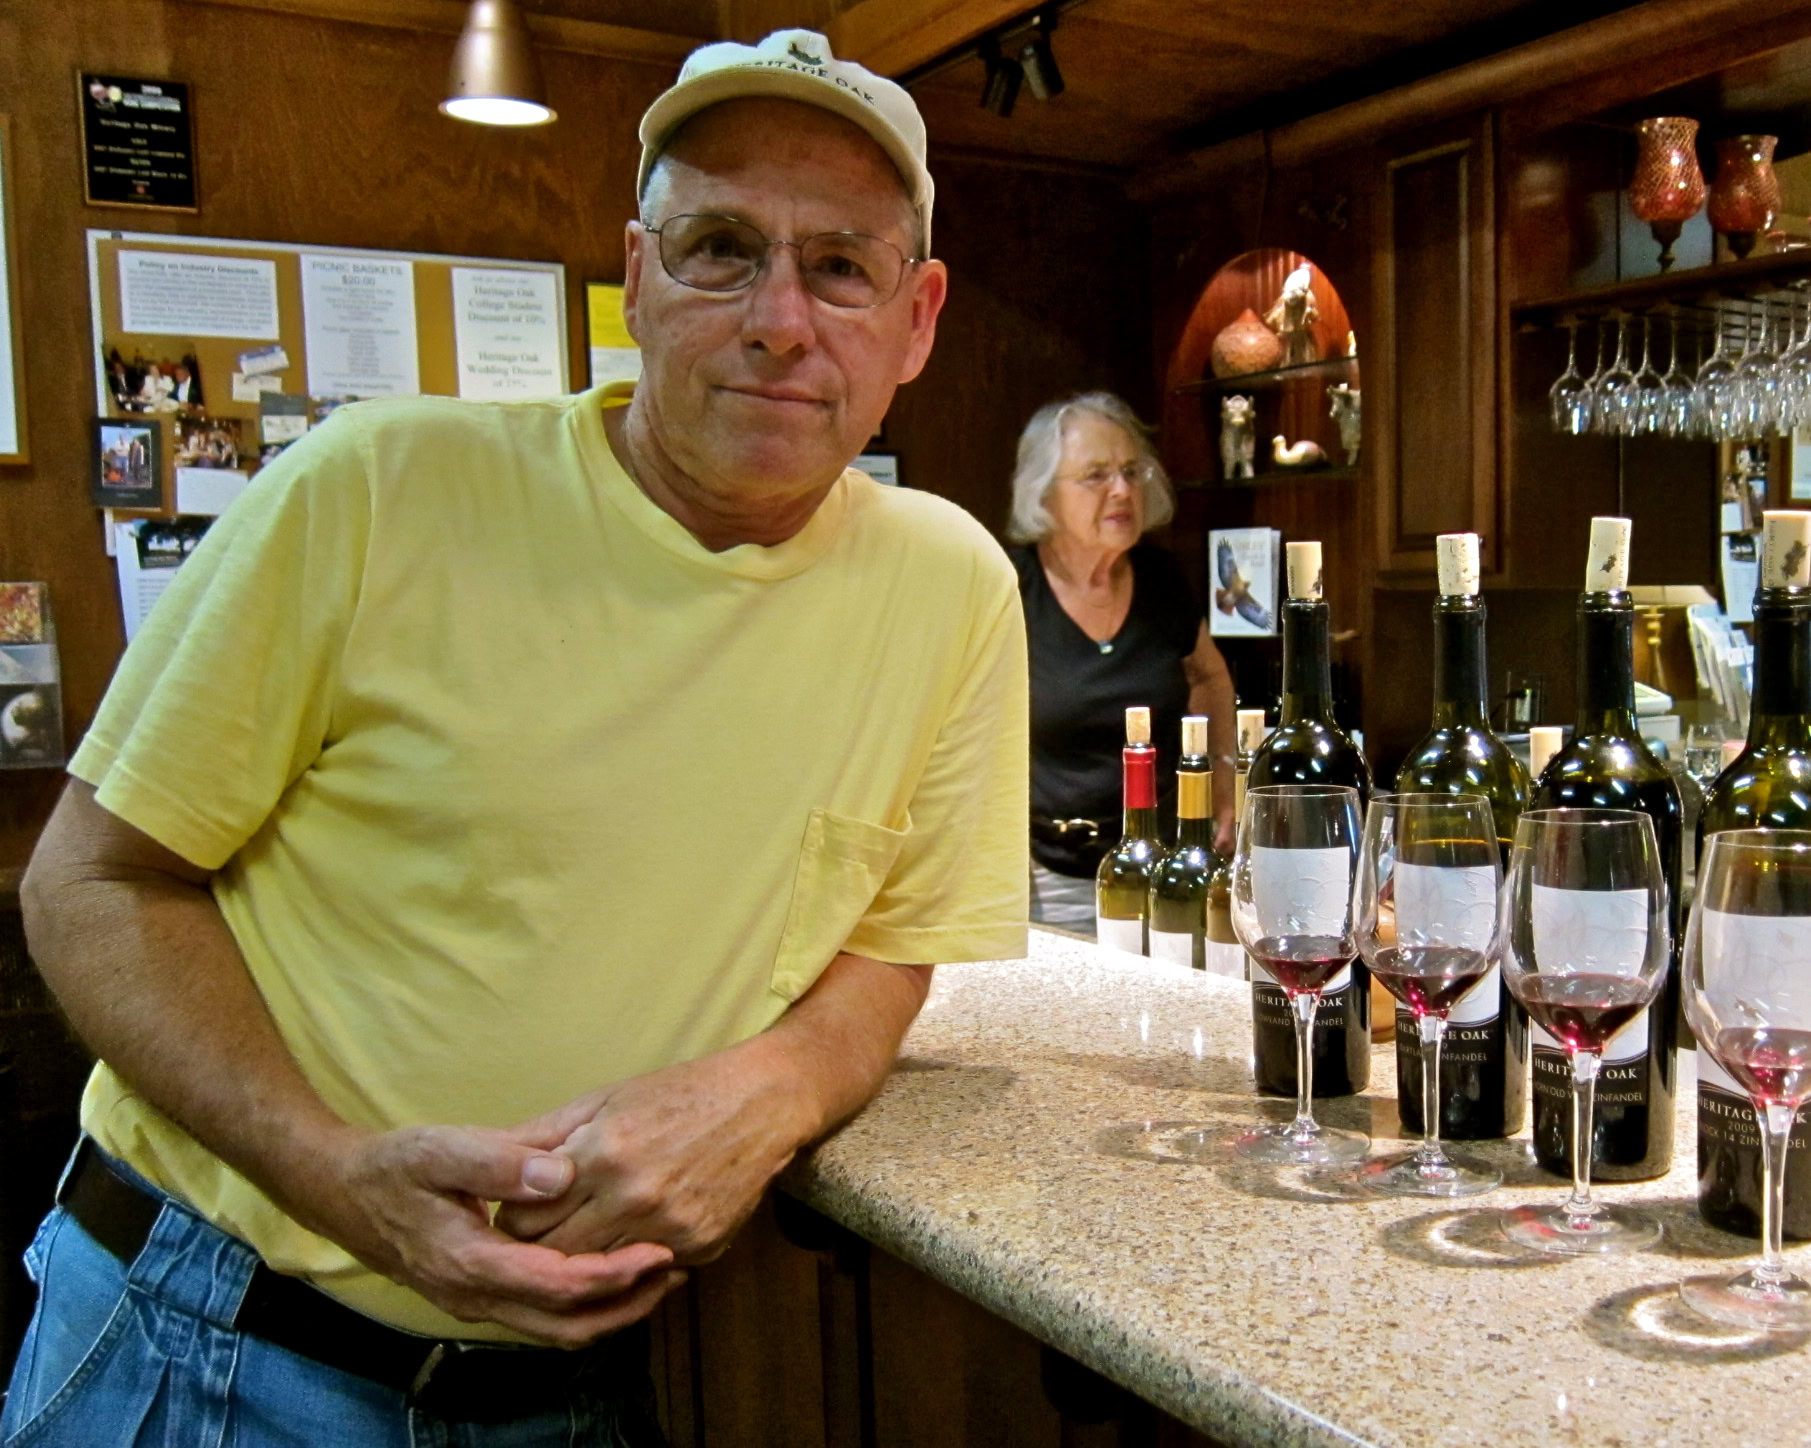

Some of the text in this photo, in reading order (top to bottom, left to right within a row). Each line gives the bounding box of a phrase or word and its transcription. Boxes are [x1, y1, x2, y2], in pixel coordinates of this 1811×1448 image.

[835, 77, 876, 105] OAK
[352, 264, 403, 275] BASKETS
[1255, 992, 1343, 1008] HERITA OAK
[1256, 1012, 1290, 1026] OWLAND
[1461, 1030, 1489, 1041] OAK
[1441, 1052, 1488, 1061] NFANDEL
[1606, 1067, 1638, 1080] OAK
[1549, 1086, 1566, 1098] OLD
[1699, 1096, 1753, 1121] HERITAG
[1728, 1121, 1756, 1133] 2009
[1740, 1134, 1807, 1149] ZINDEL
